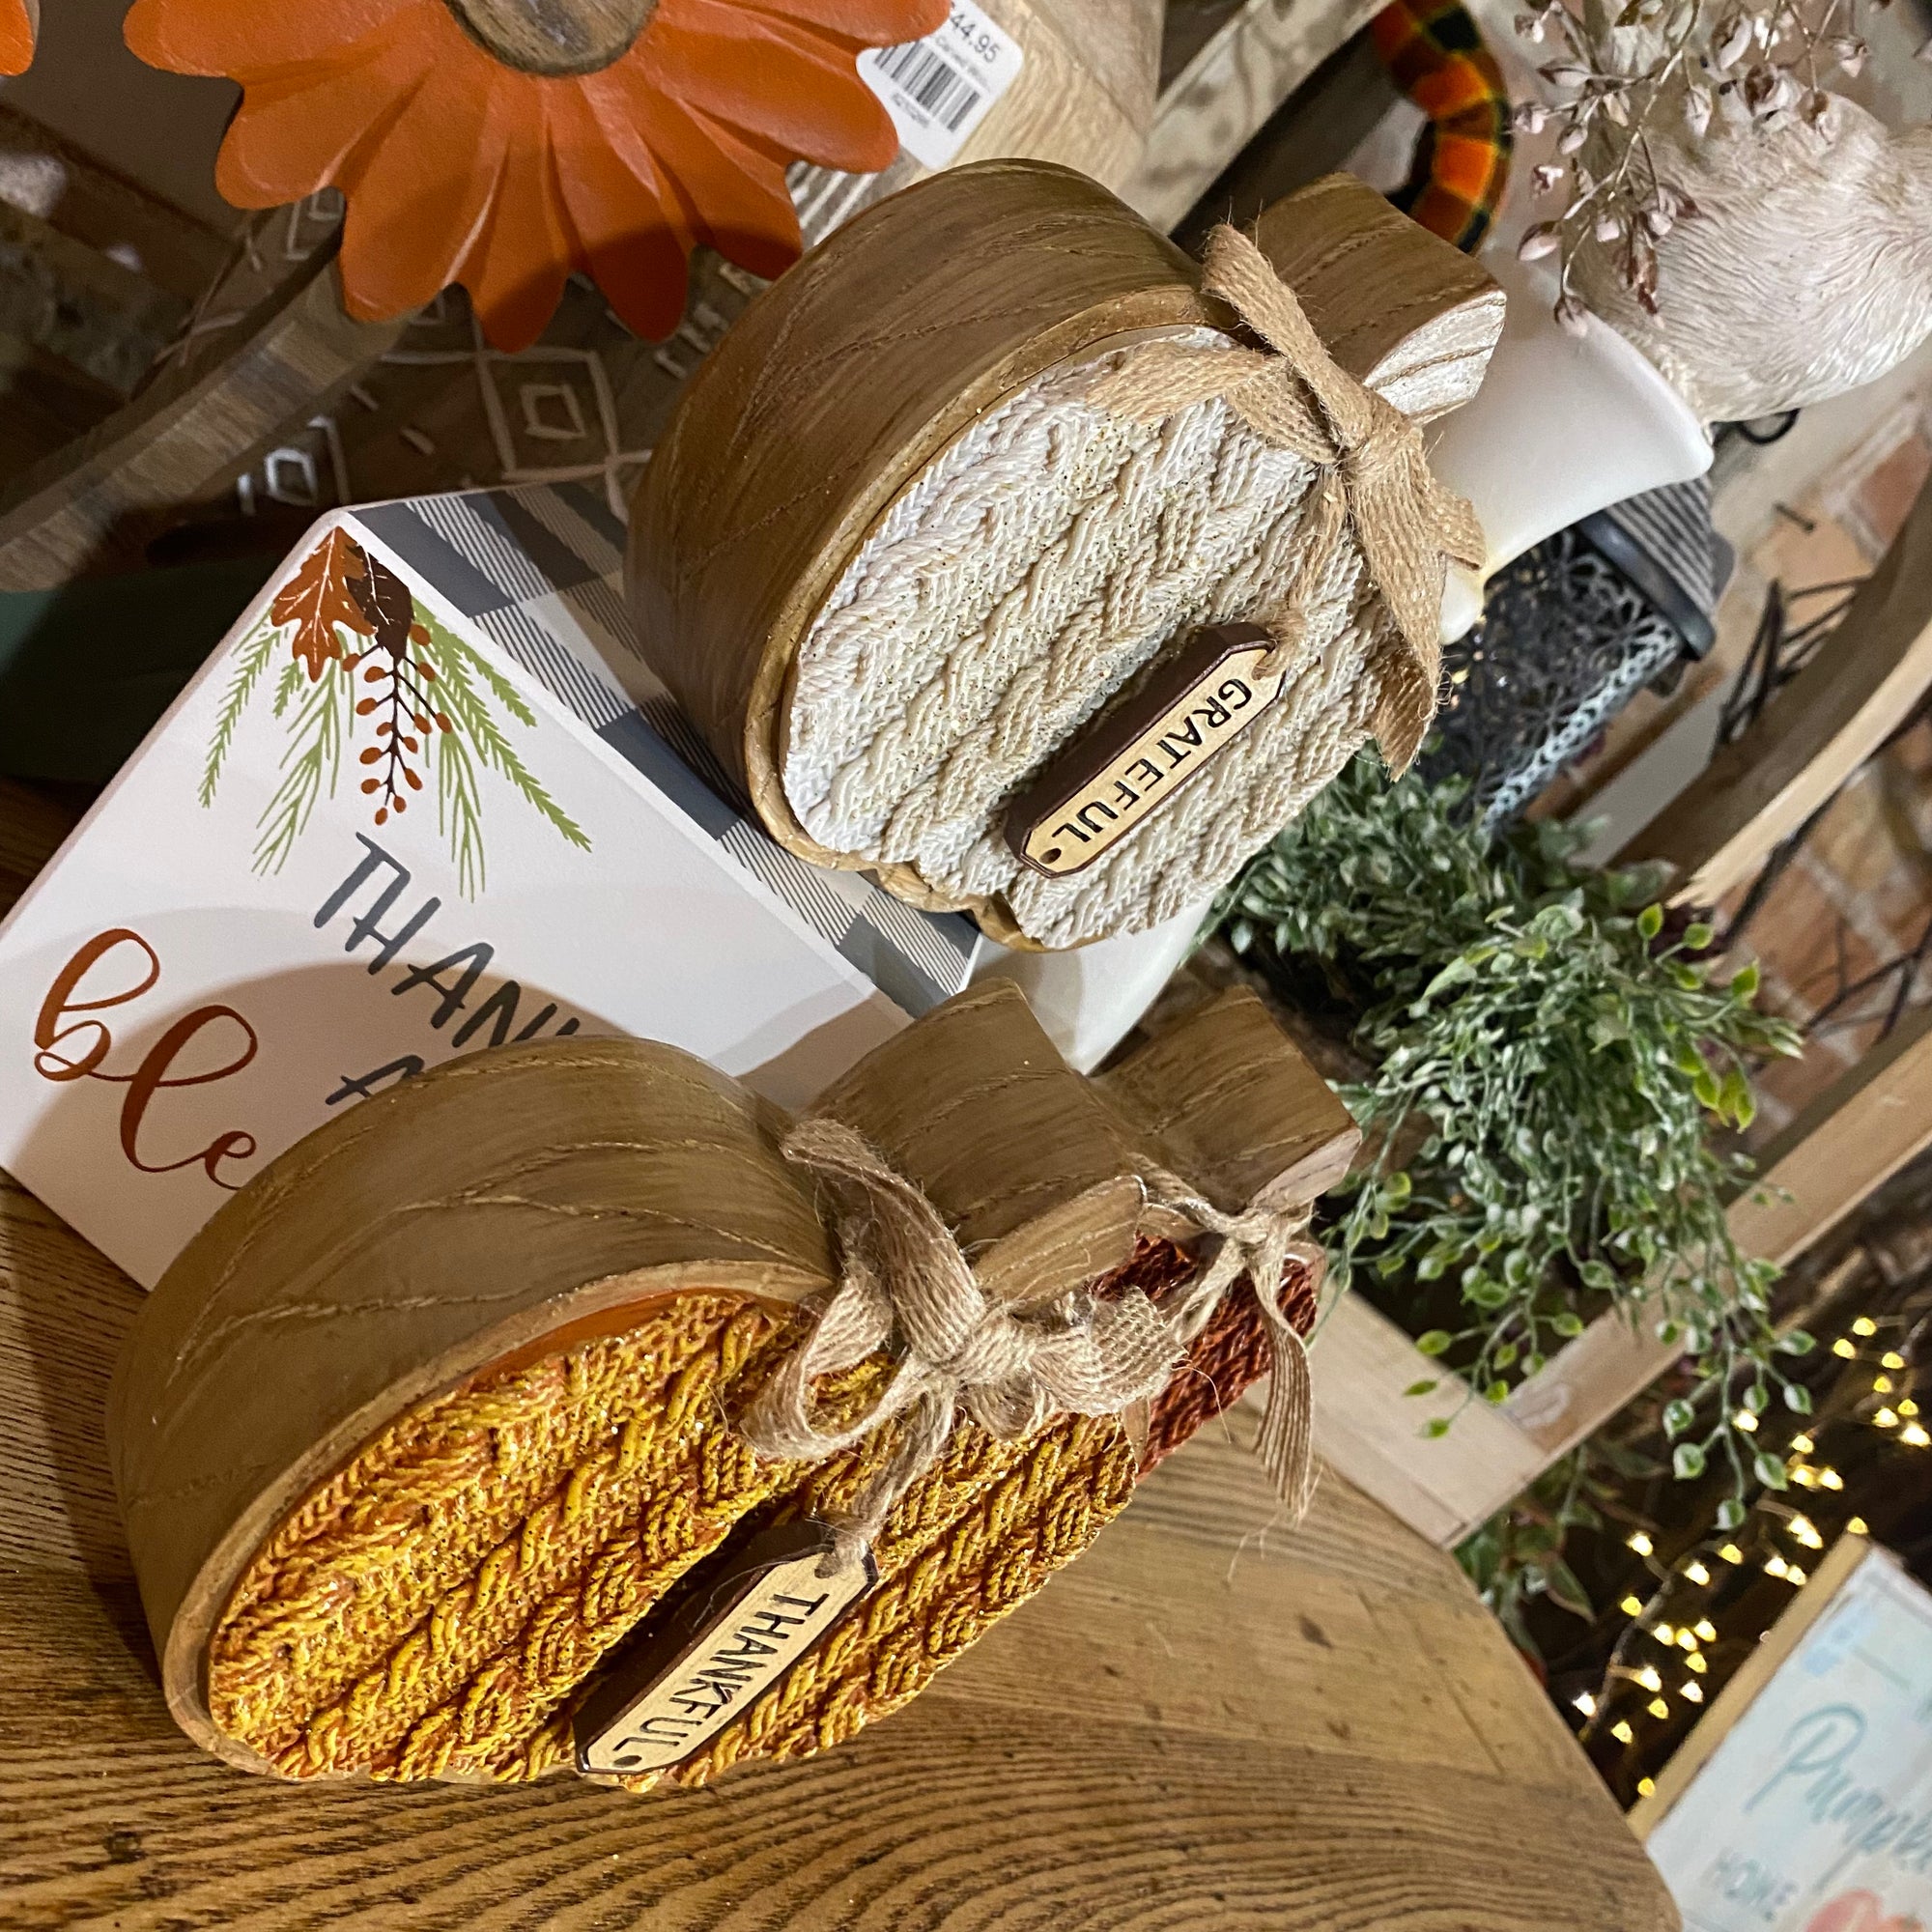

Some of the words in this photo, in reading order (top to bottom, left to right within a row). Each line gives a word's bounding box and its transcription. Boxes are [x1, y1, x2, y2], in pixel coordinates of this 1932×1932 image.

[949, 2, 1001, 63] 44.95
[1051, 678, 1253, 843] GRATEFUL
[313, 831, 581, 1049] THAN
[611, 1593, 831, 1752] THANKFUL
